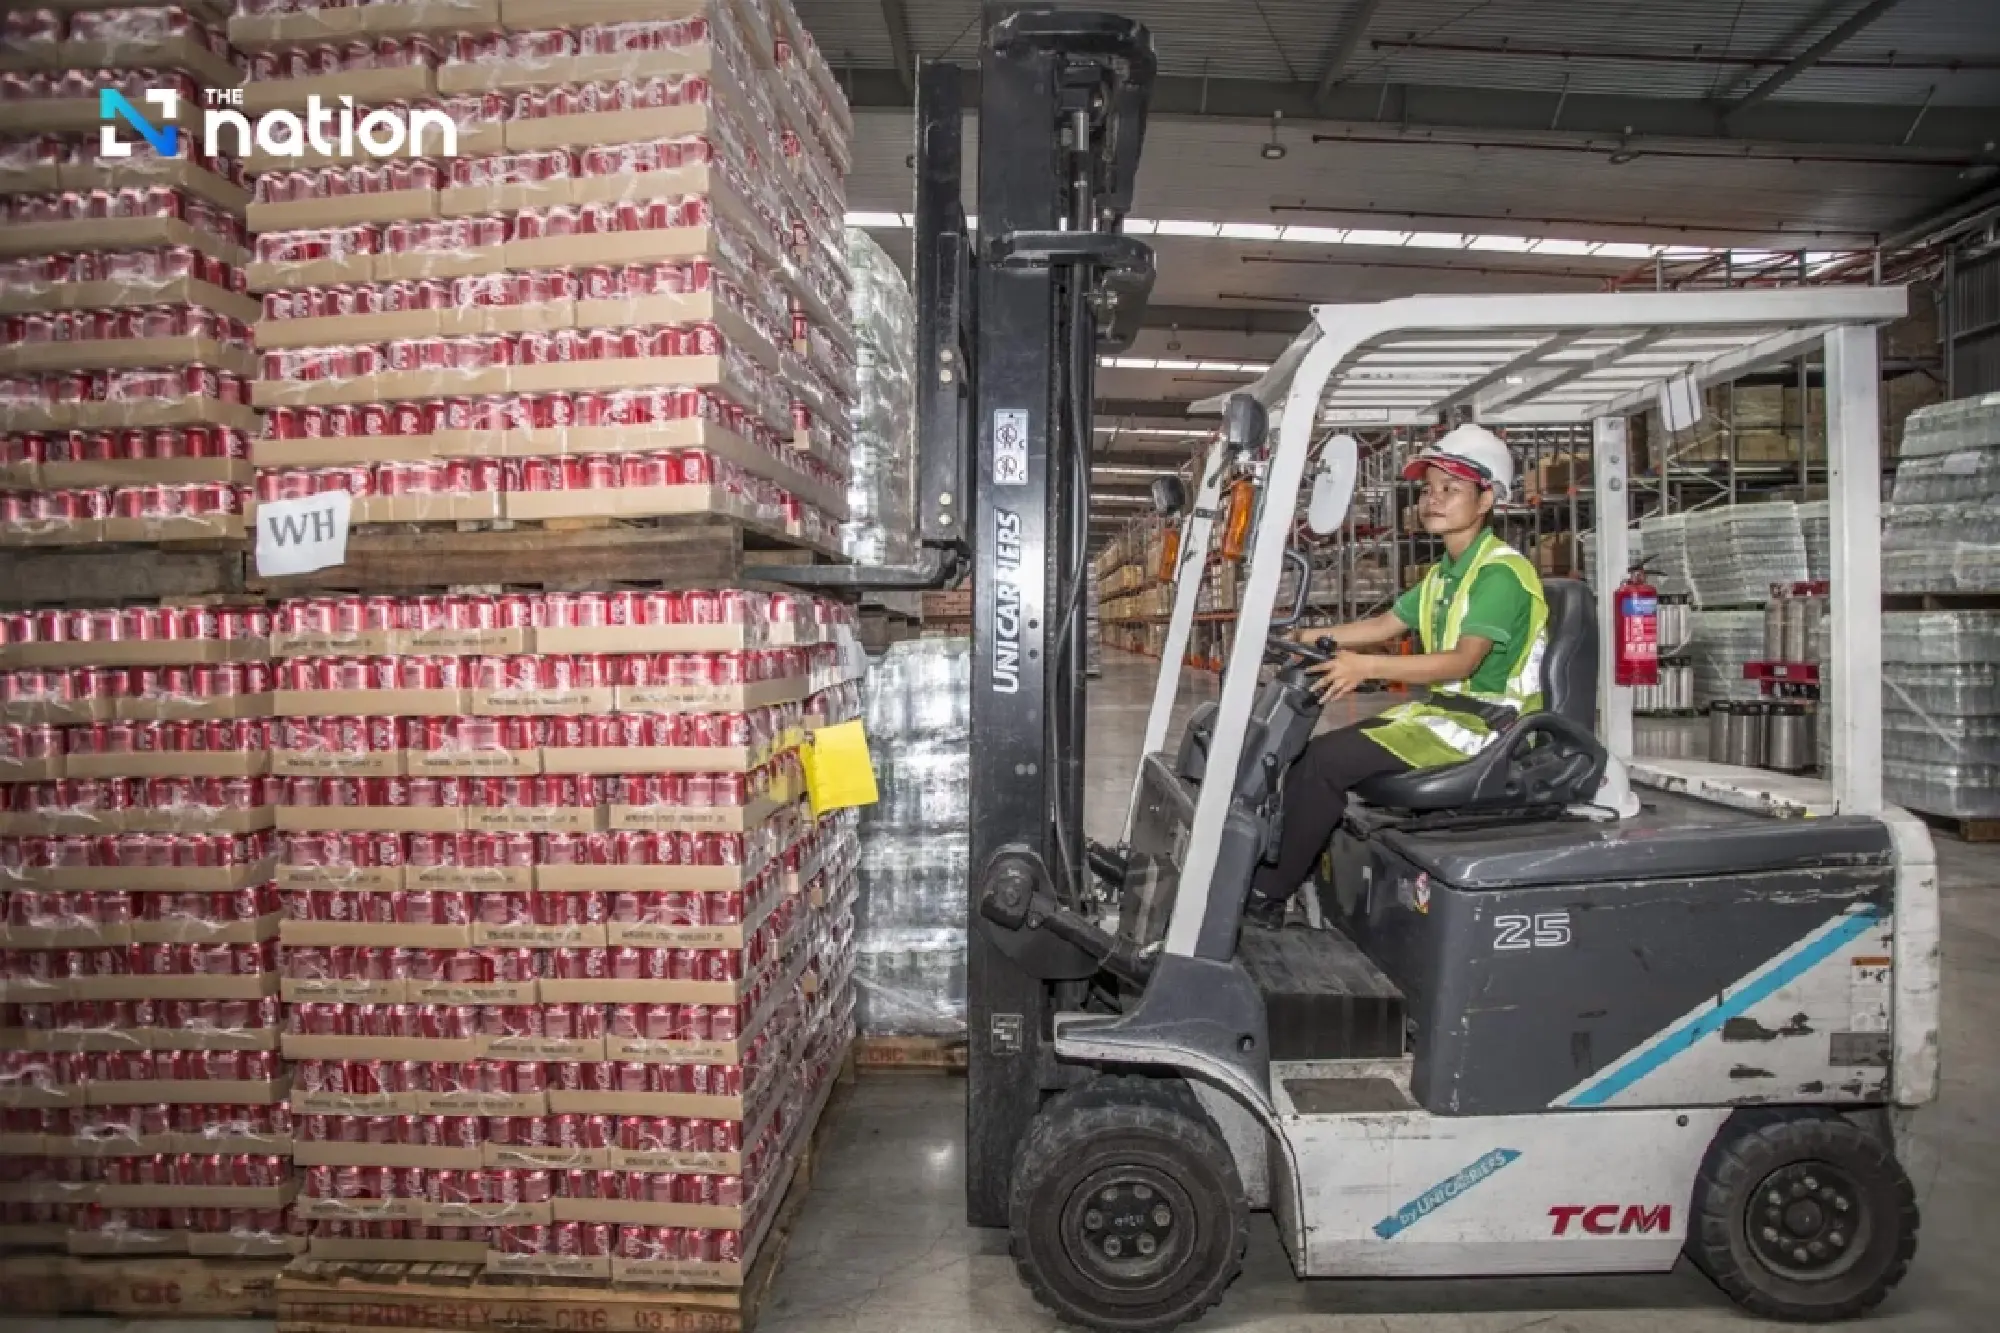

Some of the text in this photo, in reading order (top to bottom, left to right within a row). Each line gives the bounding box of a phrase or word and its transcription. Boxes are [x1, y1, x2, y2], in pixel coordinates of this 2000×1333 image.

[268, 508, 335, 547] WH
[992, 509, 1021, 695] UNICARIERS
[1493, 912, 1571, 949] 25
[1547, 1204, 1671, 1236] TCM
